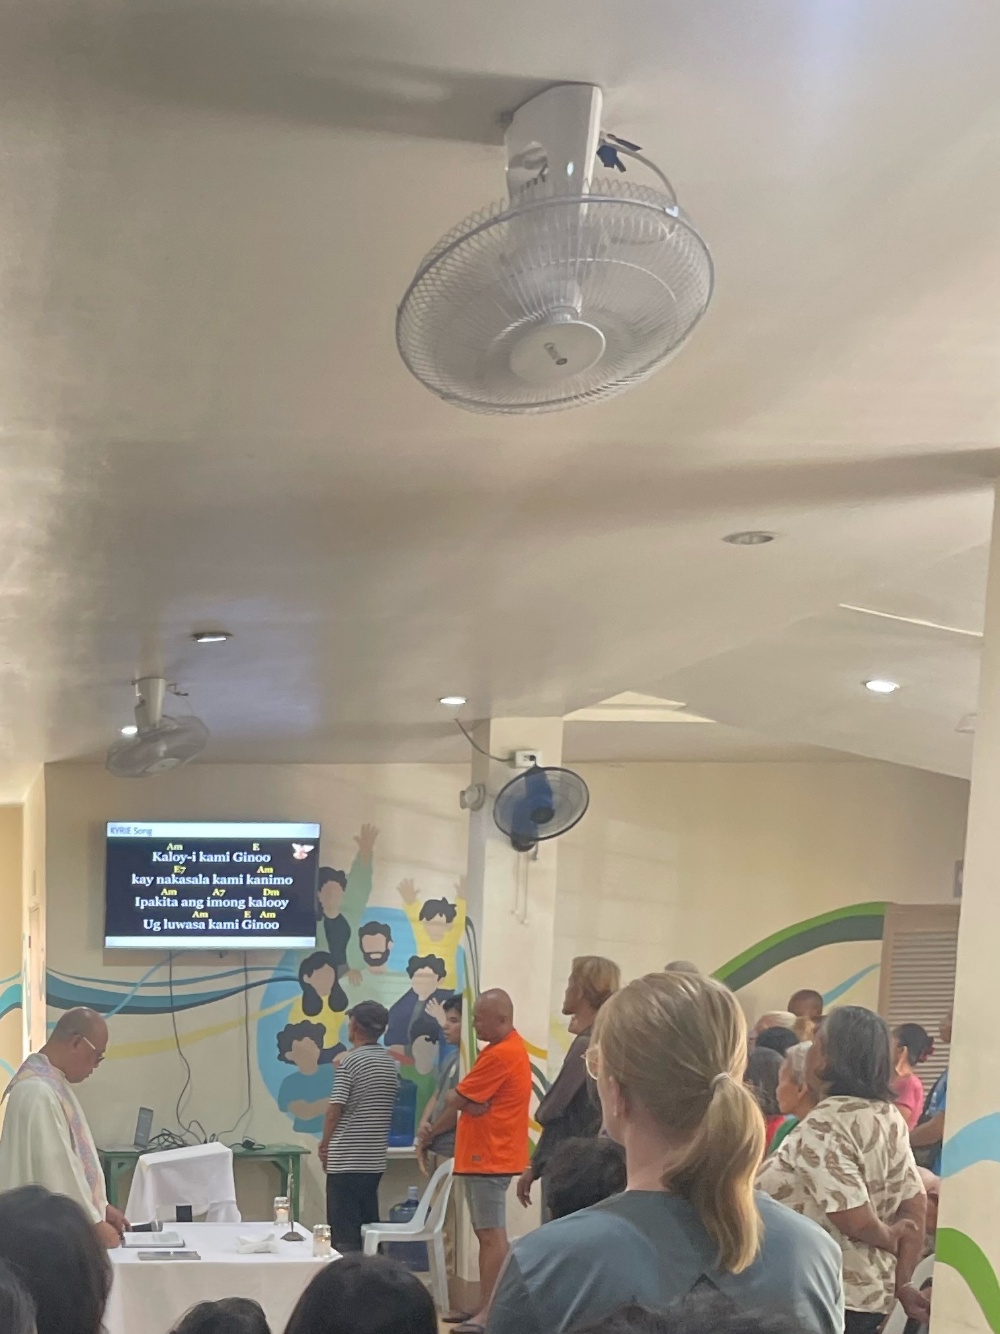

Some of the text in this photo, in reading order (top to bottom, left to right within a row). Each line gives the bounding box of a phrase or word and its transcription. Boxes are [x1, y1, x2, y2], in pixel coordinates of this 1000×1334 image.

[134, 827, 153, 837] Song
[166, 842, 260, 851] Am E
[152, 851, 271, 864] Kaloy-i kami Ginoo
[173, 865, 274, 875] E7 Am
[131, 873, 293, 886] kay nakasala kami kanimo
[160, 888, 280, 897] Am A7 Dm
[135, 896, 290, 910] Ipakita ang imong kalooy
[192, 910, 277, 919] Am E Am
[143, 919, 280, 932] Ug luwasa kami Ginoo
